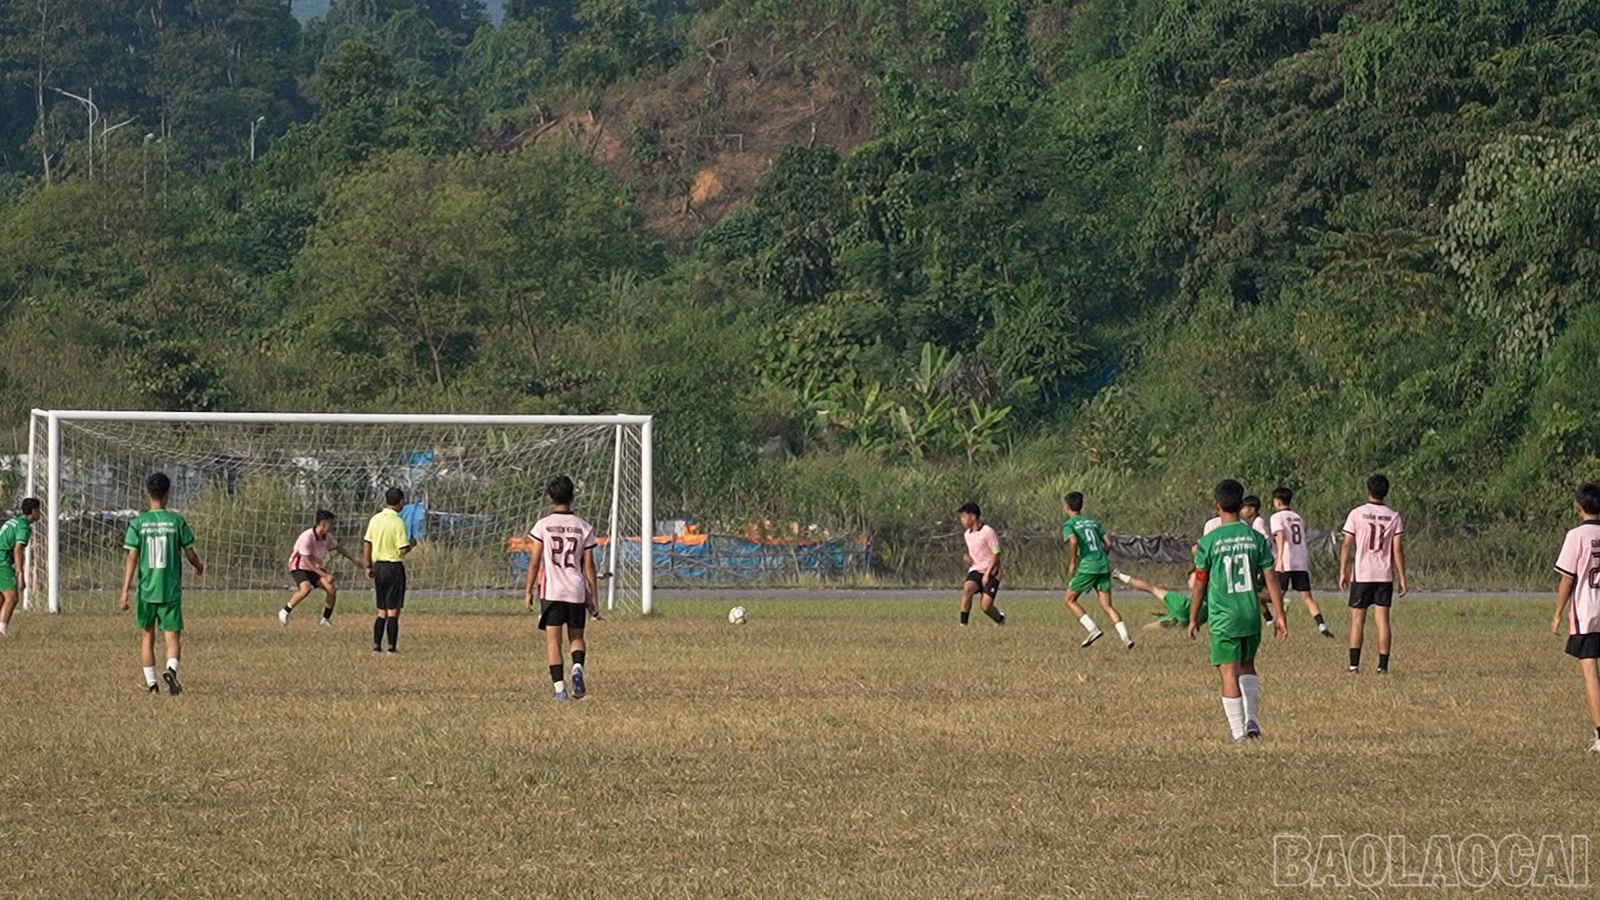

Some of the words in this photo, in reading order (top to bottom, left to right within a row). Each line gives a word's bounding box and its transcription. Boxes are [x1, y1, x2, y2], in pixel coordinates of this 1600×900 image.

[1084, 529, 1098, 551] 9
[1291, 524, 1302, 545] 8
[1368, 522, 1386, 551] 11
[551, 536, 577, 568] 22
[1223, 554, 1252, 594] 13
